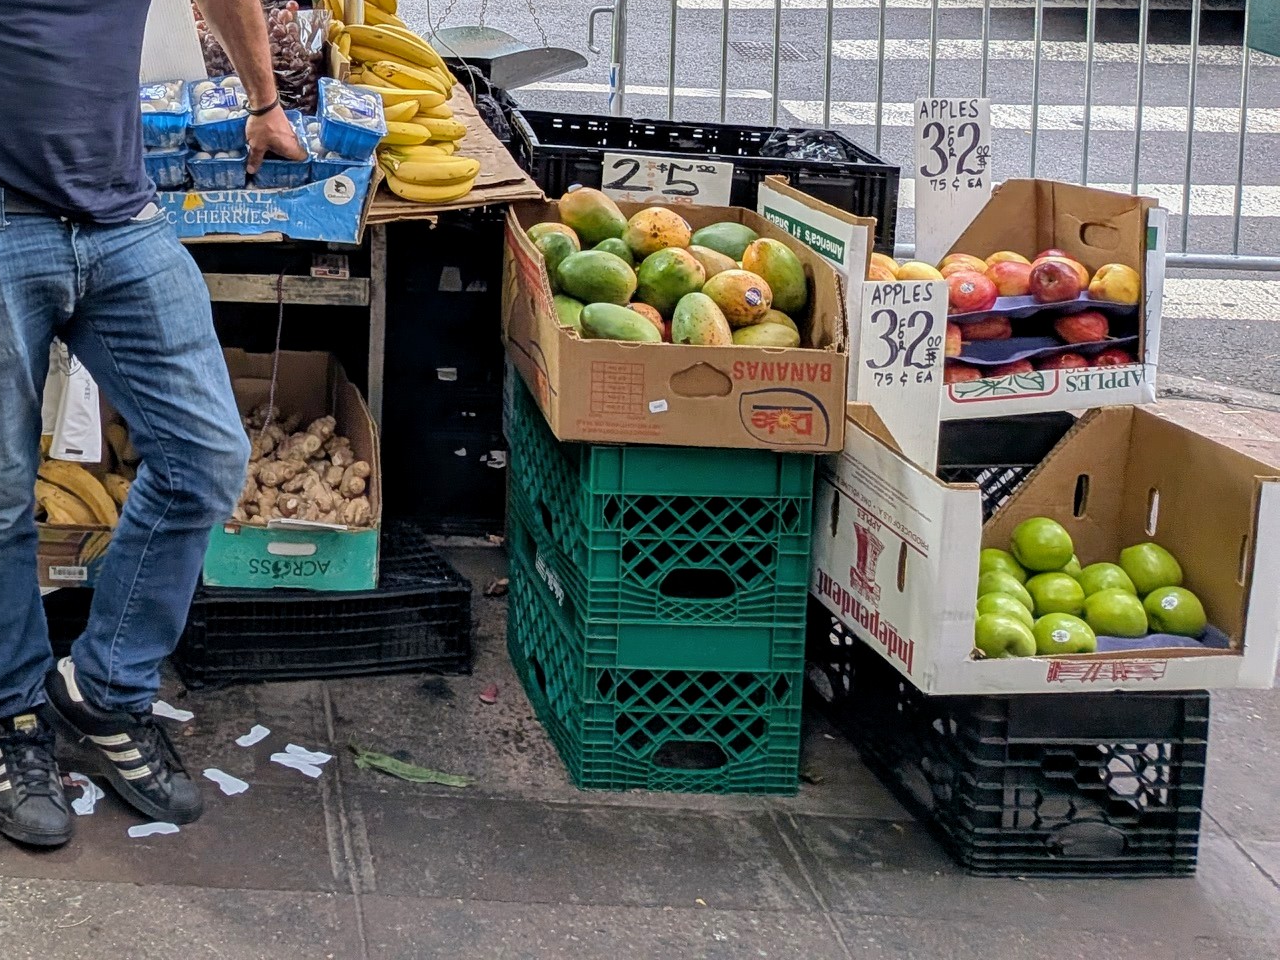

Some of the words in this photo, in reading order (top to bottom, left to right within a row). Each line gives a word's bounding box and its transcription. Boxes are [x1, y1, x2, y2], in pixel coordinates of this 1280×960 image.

[919, 98, 980, 120] APPLES
[919, 120, 949, 178] 3
[955, 121, 986, 176] 2
[602, 157, 654, 192] 2
[661, 161, 700, 197] 5
[929, 178, 946, 191] 75
[967, 177, 983, 189] EA
[183, 209, 271, 225] CHERRIES
[870, 281, 934, 306] APPLES
[865, 308, 898, 370] 3
[902, 309, 935, 370] 2
[731, 360, 833, 383] BANANAS
[873, 372, 894, 387] 75
[916, 371, 934, 384] EA
[1064, 368, 1144, 393] APPLES
[750, 408, 814, 437] Dole
[856, 507, 883, 533] APPLES
[815, 566, 916, 677] Independent
